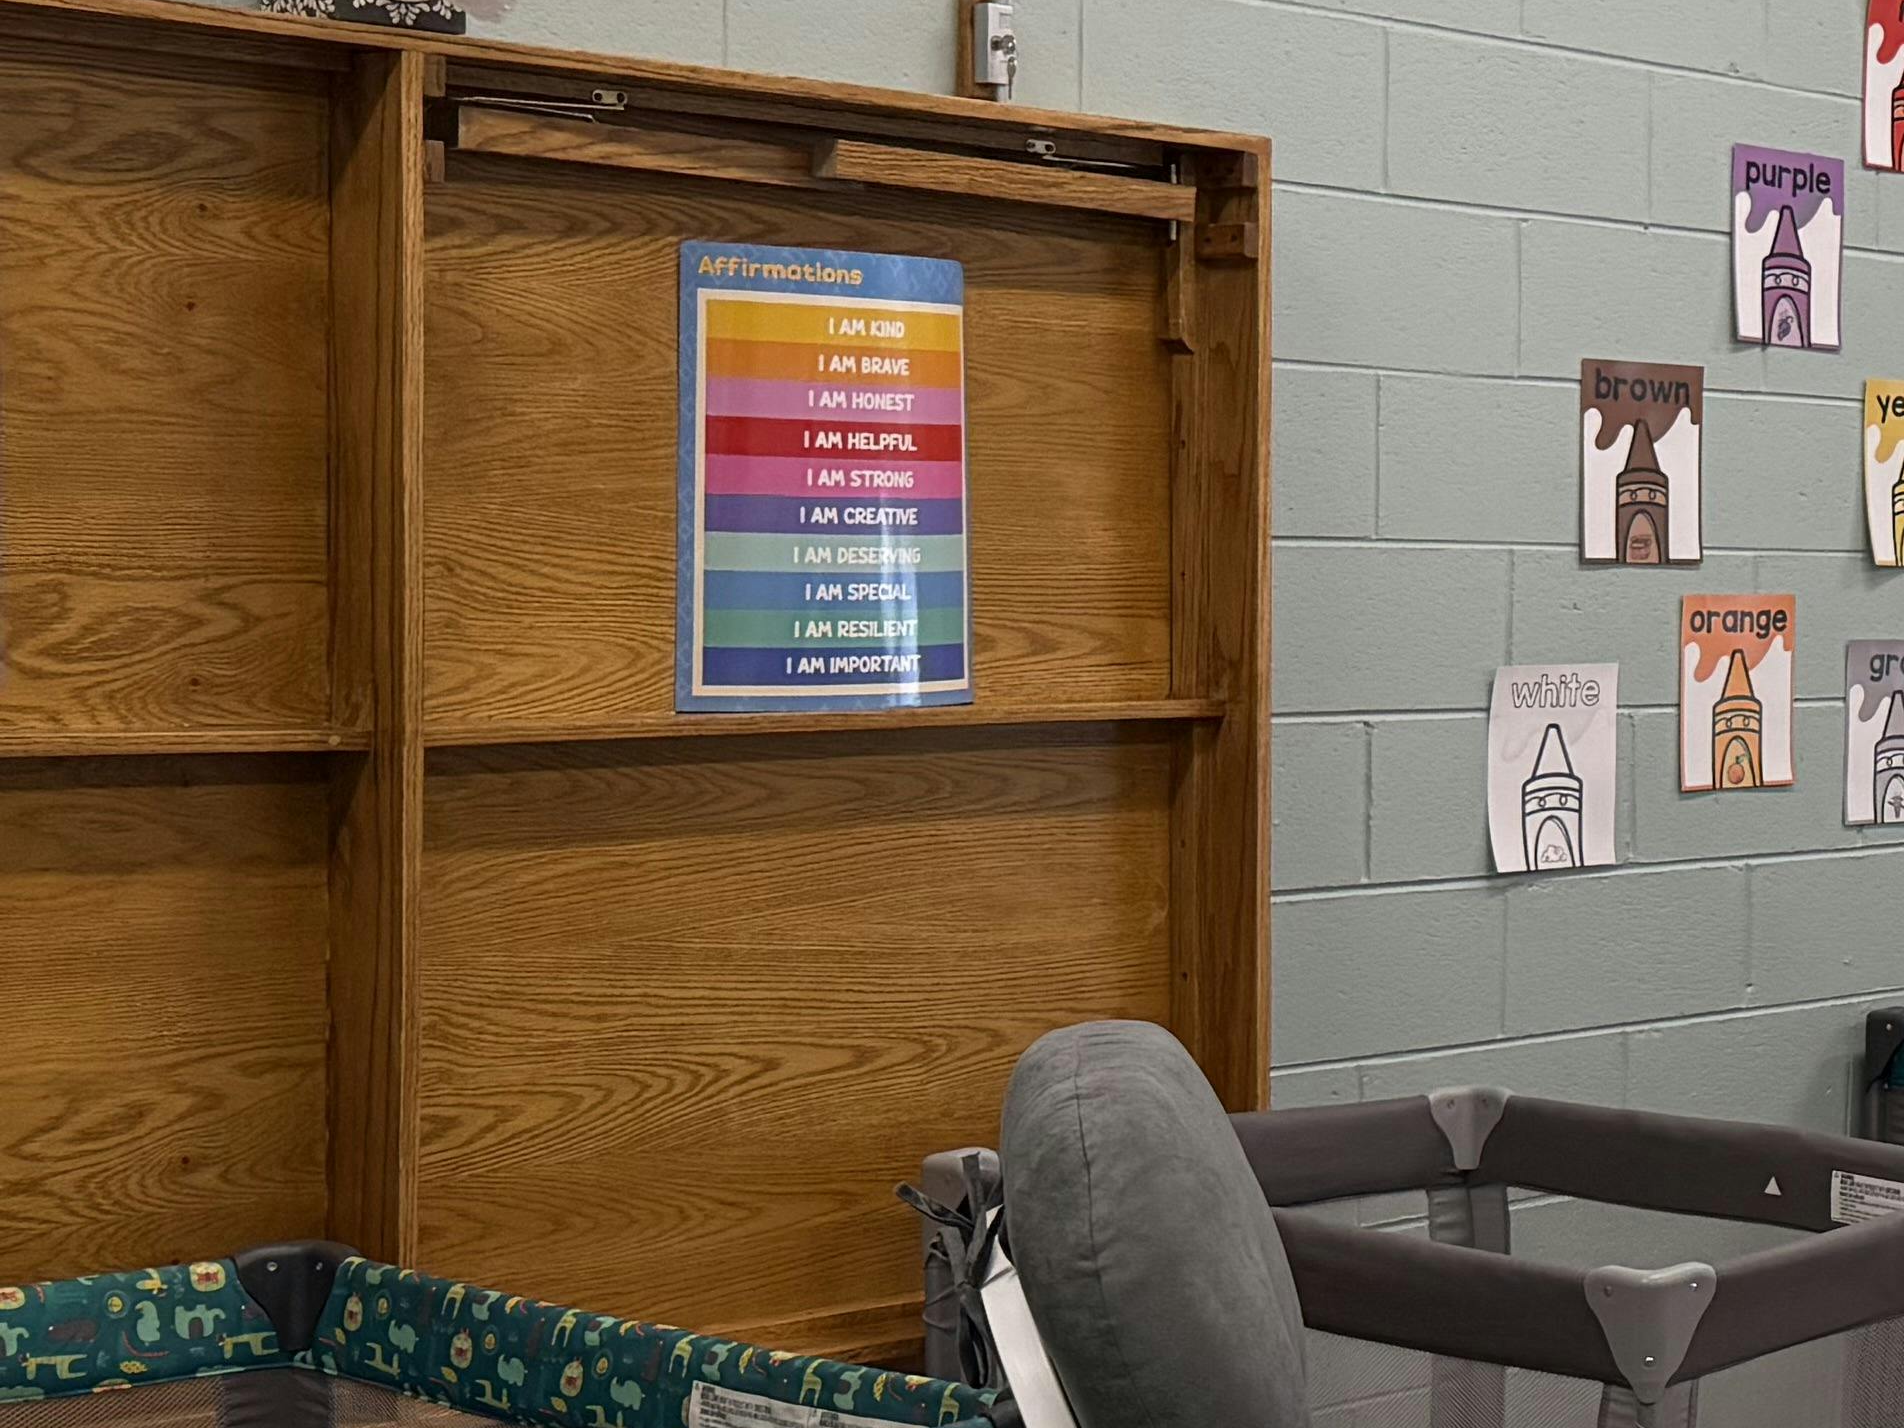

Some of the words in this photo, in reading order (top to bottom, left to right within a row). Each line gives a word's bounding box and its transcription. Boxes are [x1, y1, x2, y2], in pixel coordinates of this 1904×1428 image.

[1744, 158, 1832, 197] purple
[698, 256, 864, 285] Affirmations
[829, 318, 834, 334] I
[840, 318, 866, 335] AM
[870, 320, 905, 337] KIND
[818, 355, 824, 372] I
[830, 355, 856, 373] AM
[862, 358, 910, 376] BRAVE
[1594, 370, 1691, 408] brown
[808, 390, 814, 407] I
[820, 391, 847, 409] AM
[852, 393, 915, 411] HONEST
[804, 430, 809, 448] I
[815, 431, 842, 449] AM
[847, 433, 918, 452] HELPFUL
[807, 468, 812, 486] I
[817, 469, 845, 487] AM
[850, 471, 914, 488] STRONG
[800, 507, 805, 523] I
[810, 507, 838, 524] AM
[844, 508, 918, 525] CREATIVE
[793, 546, 799, 563] I
[804, 547, 831, 564] AM
[837, 547, 921, 564] DESERVING
[805, 583, 811, 600] I
[816, 584, 842, 601] AM
[848, 583, 912, 601] SPECIAL
[794, 621, 800, 638] I
[805, 621, 832, 638] AM
[838, 619, 918, 638] RESILIENT
[1689, 603, 1788, 640] orange
[786, 657, 792, 674] I
[797, 656, 825, 674] AM
[830, 654, 921, 674] IMPORTANT
[1511, 673, 1600, 710] white
